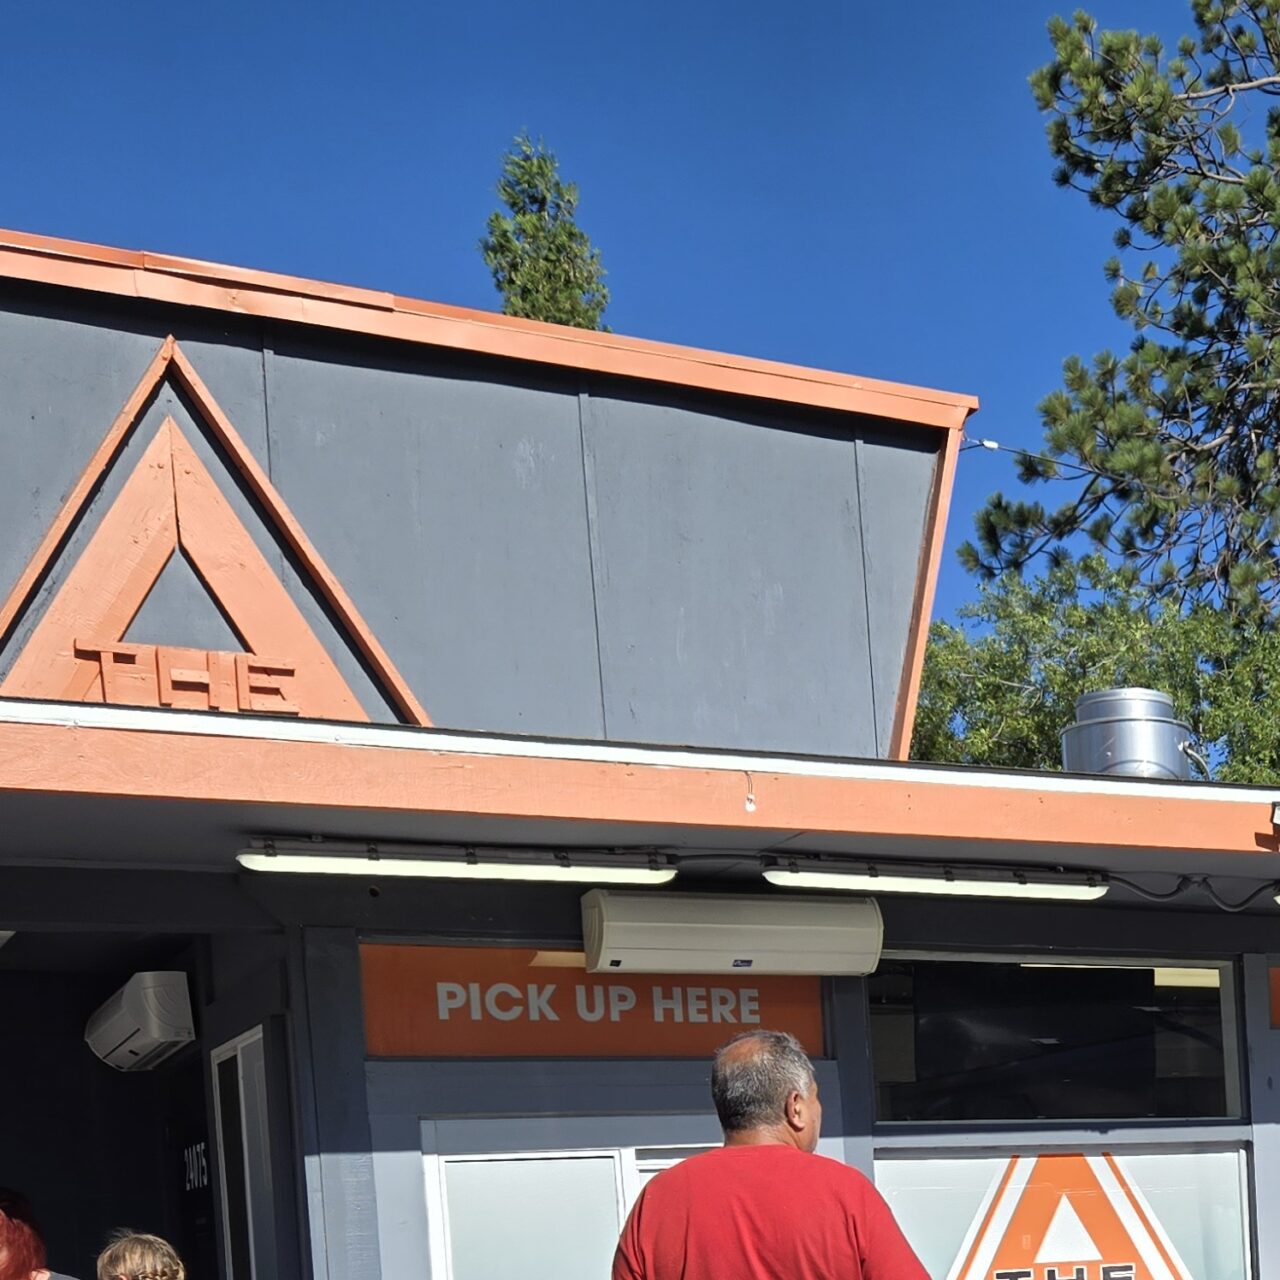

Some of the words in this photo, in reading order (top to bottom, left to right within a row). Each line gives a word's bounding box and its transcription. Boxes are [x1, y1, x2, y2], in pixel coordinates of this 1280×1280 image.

[74, 638, 300, 716] THE
[436, 982, 560, 1021] PICK
[575, 985, 636, 1021] UP
[652, 986, 760, 1024] HERE
